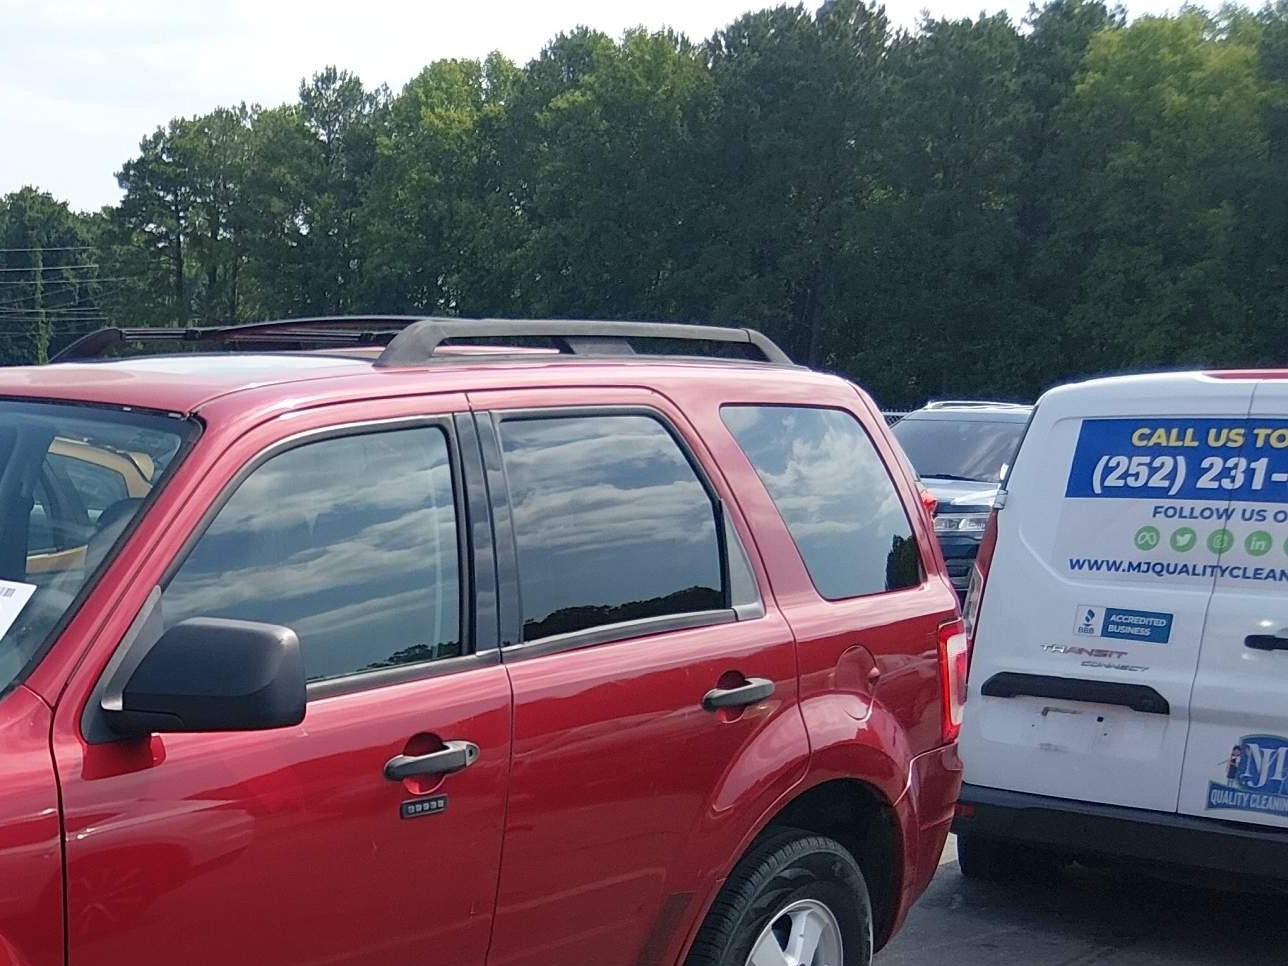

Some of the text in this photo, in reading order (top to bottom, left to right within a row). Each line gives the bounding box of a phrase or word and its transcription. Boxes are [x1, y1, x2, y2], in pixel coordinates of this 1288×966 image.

[1131, 427, 1199, 447] CALL
[1207, 428, 1246, 448] US
[1092, 455, 1187, 496] (252)
[1152, 505, 1235, 521] FOLLOW
[1241, 508, 1268, 523] US
[1110, 613, 1168, 628] ACCREDITED
[1108, 624, 1152, 637] BUSINESS
[1040, 643, 1129, 659] TRANSIT
[1080, 660, 1151, 672] CONNECT
[1211, 789, 1250, 807] QUALITY
